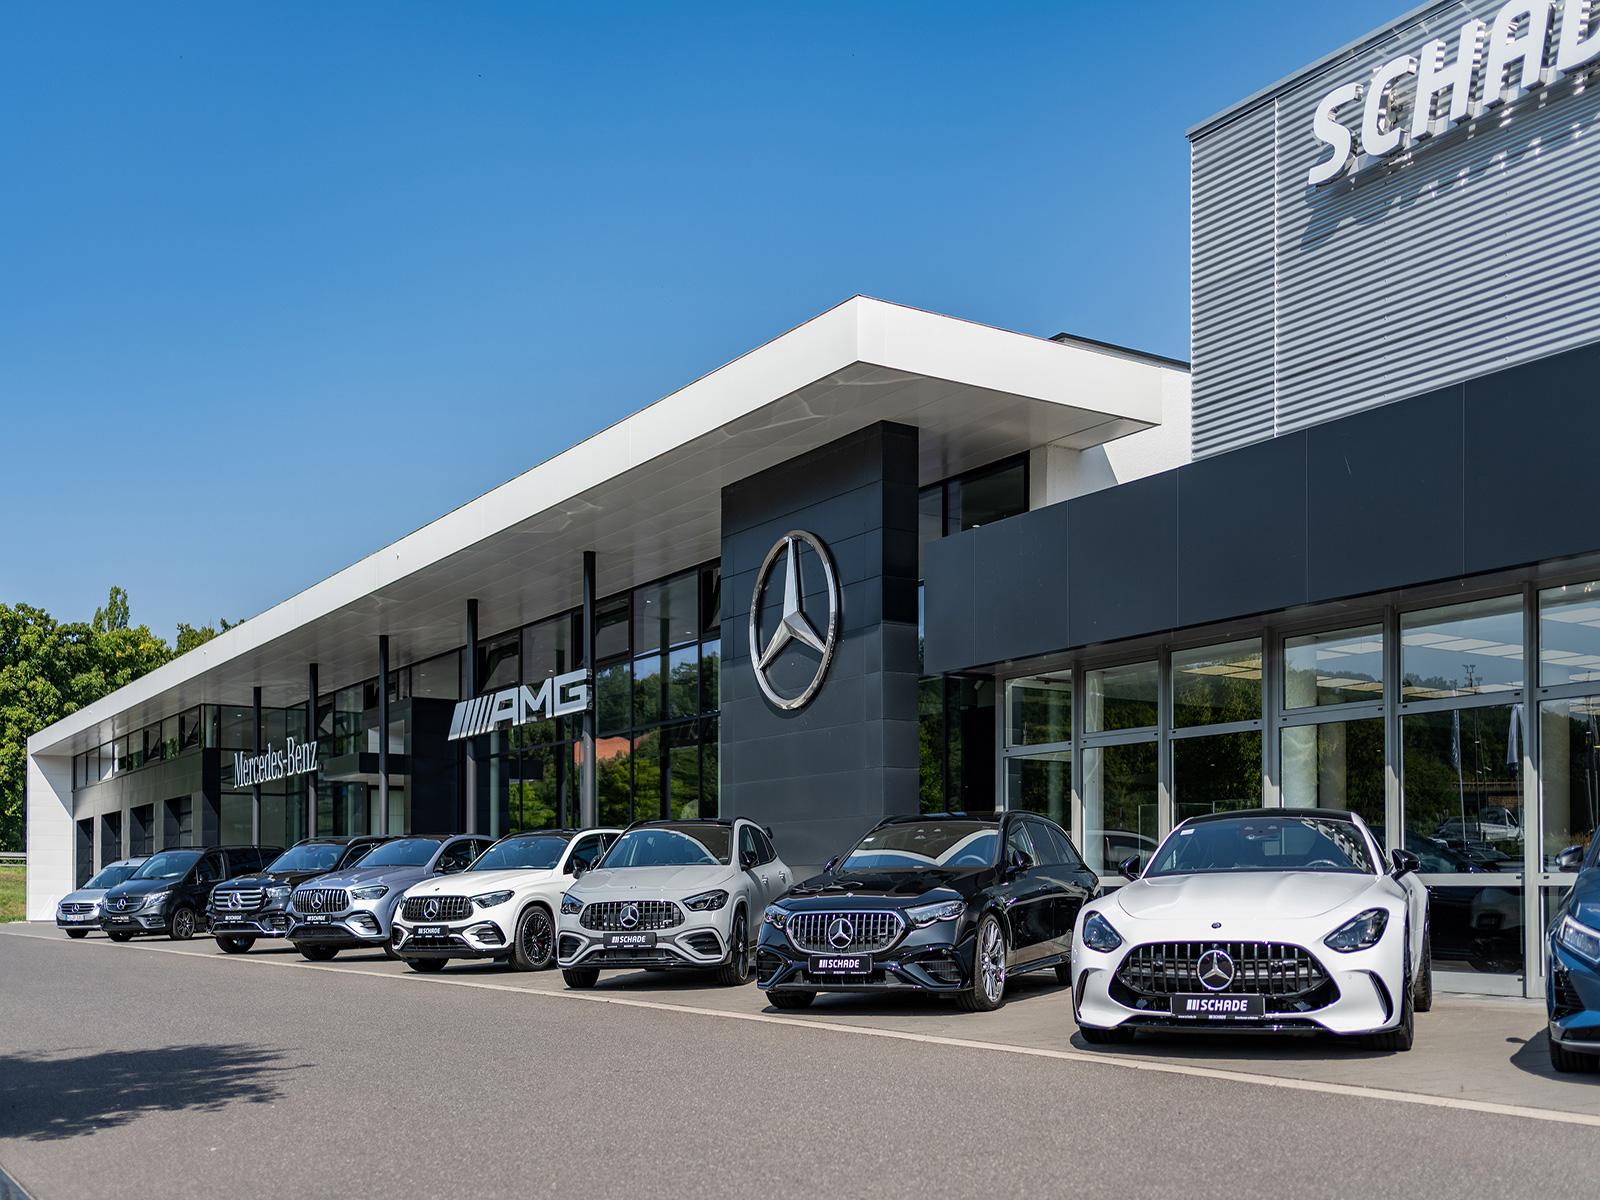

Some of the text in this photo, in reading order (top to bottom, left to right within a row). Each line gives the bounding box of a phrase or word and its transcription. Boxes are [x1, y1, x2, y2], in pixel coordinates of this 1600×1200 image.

[1308, 0, 1600, 186] SCHAD
[487, 668, 587, 732] AMG
[234, 736, 317, 789] Mercedes-Benz
[620, 935, 646, 943] SCHADE
[828, 959, 860, 969] SCHADE
[1200, 999, 1248, 1012] SCHADE
